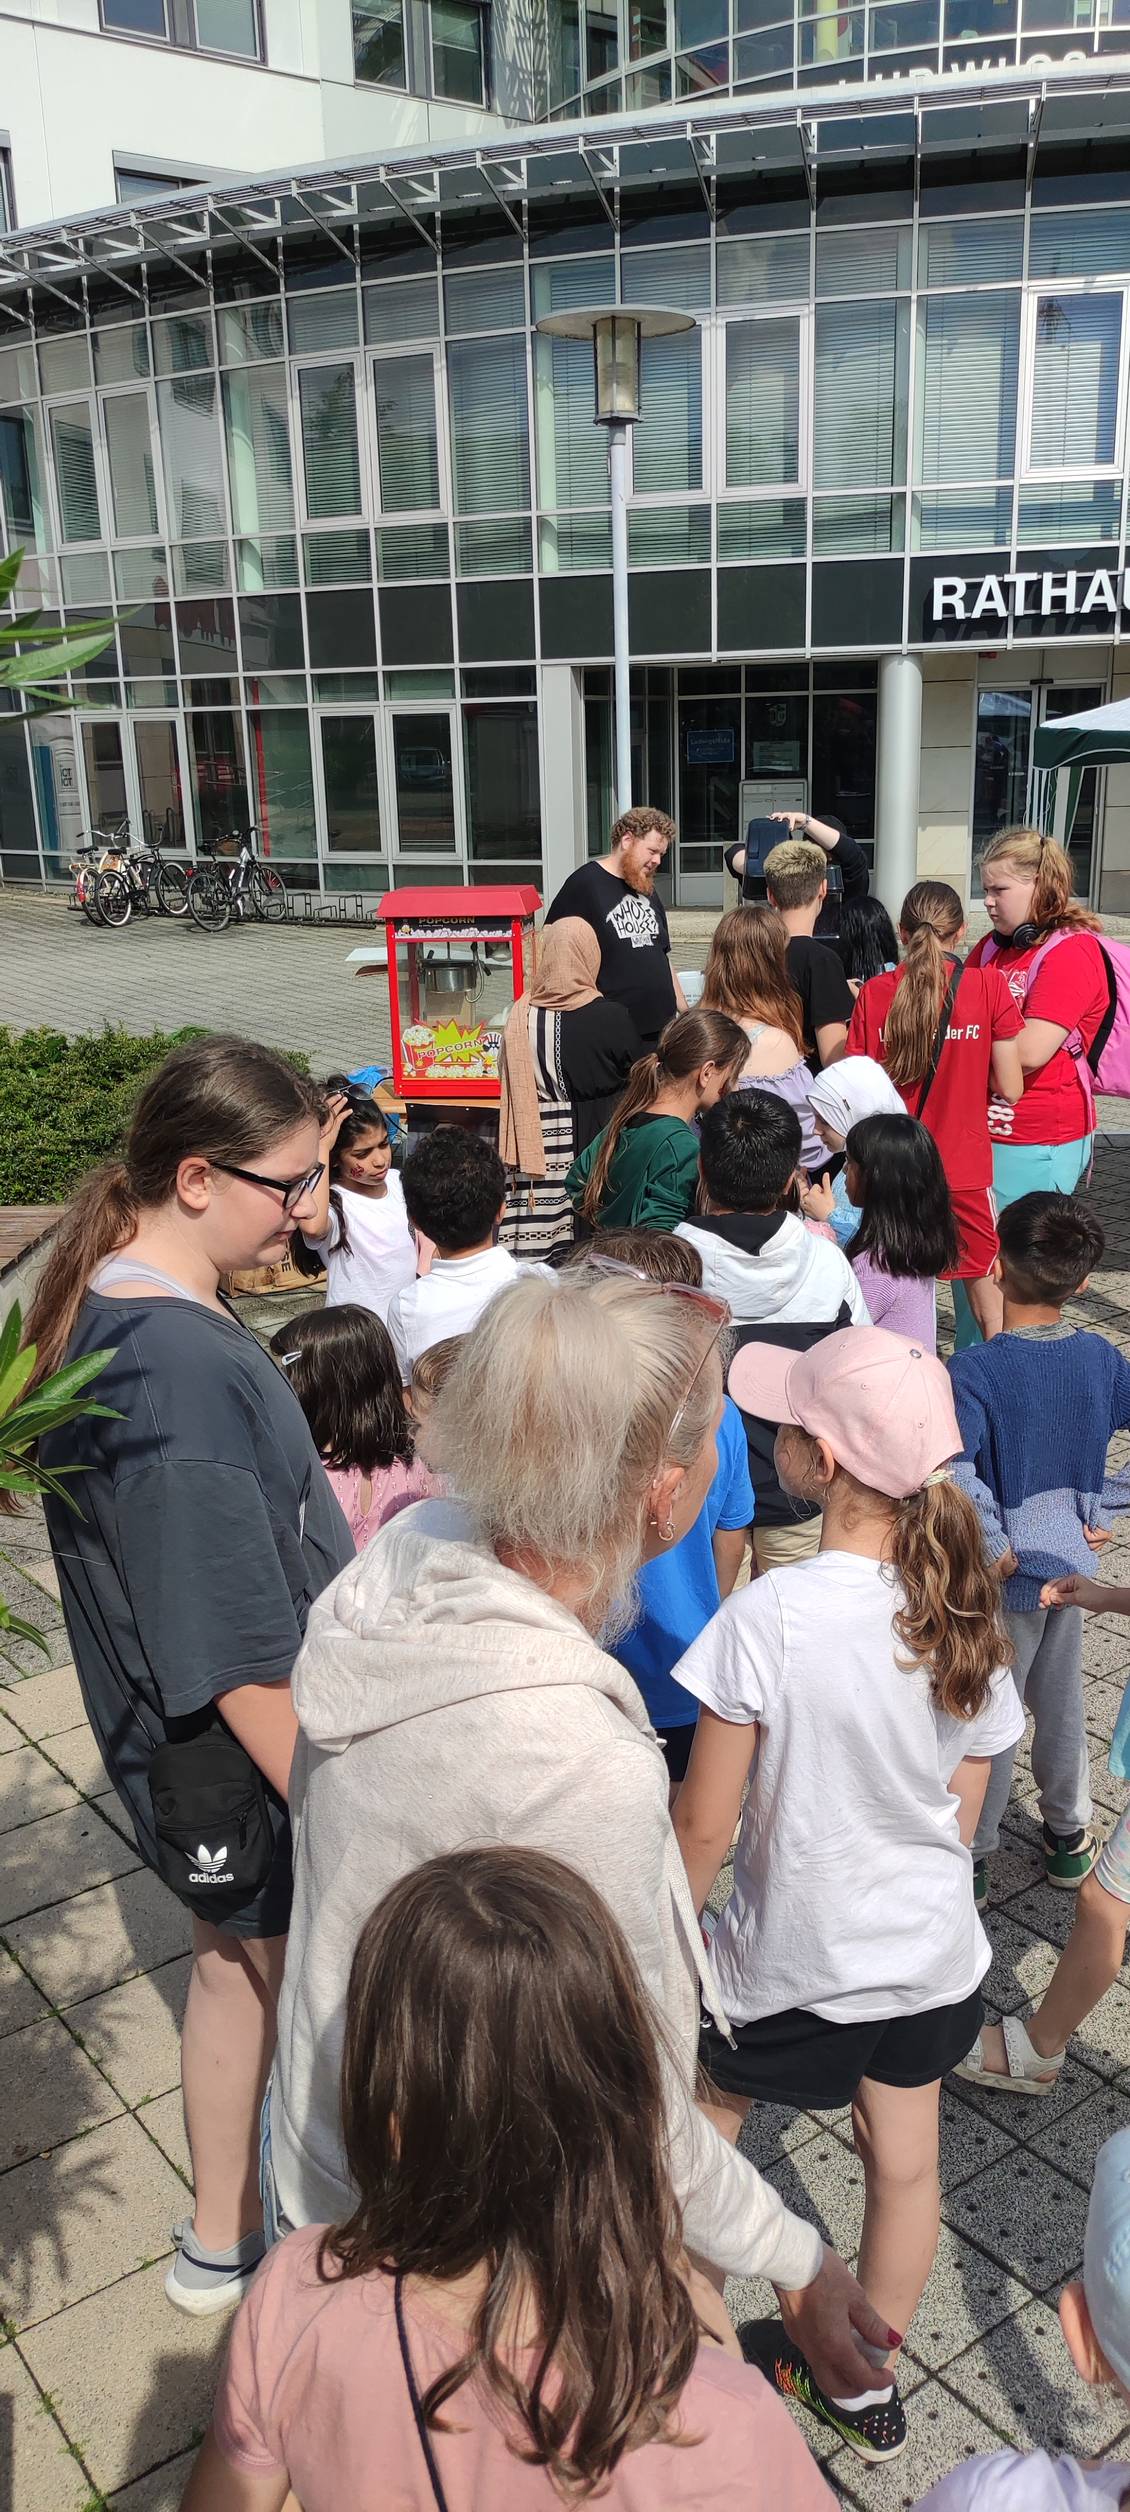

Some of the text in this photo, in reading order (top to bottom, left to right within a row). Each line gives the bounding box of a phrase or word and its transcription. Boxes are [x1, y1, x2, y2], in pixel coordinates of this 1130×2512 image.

[932, 567, 1130, 621] RATHA
[418, 916, 475, 924] POPCORN
[616, 919, 657, 935] HOUSE?
[965, 1024, 980, 1040] FC
[417, 1038, 485, 1058] POPCORN
[188, 1872, 234, 1883] adidas
